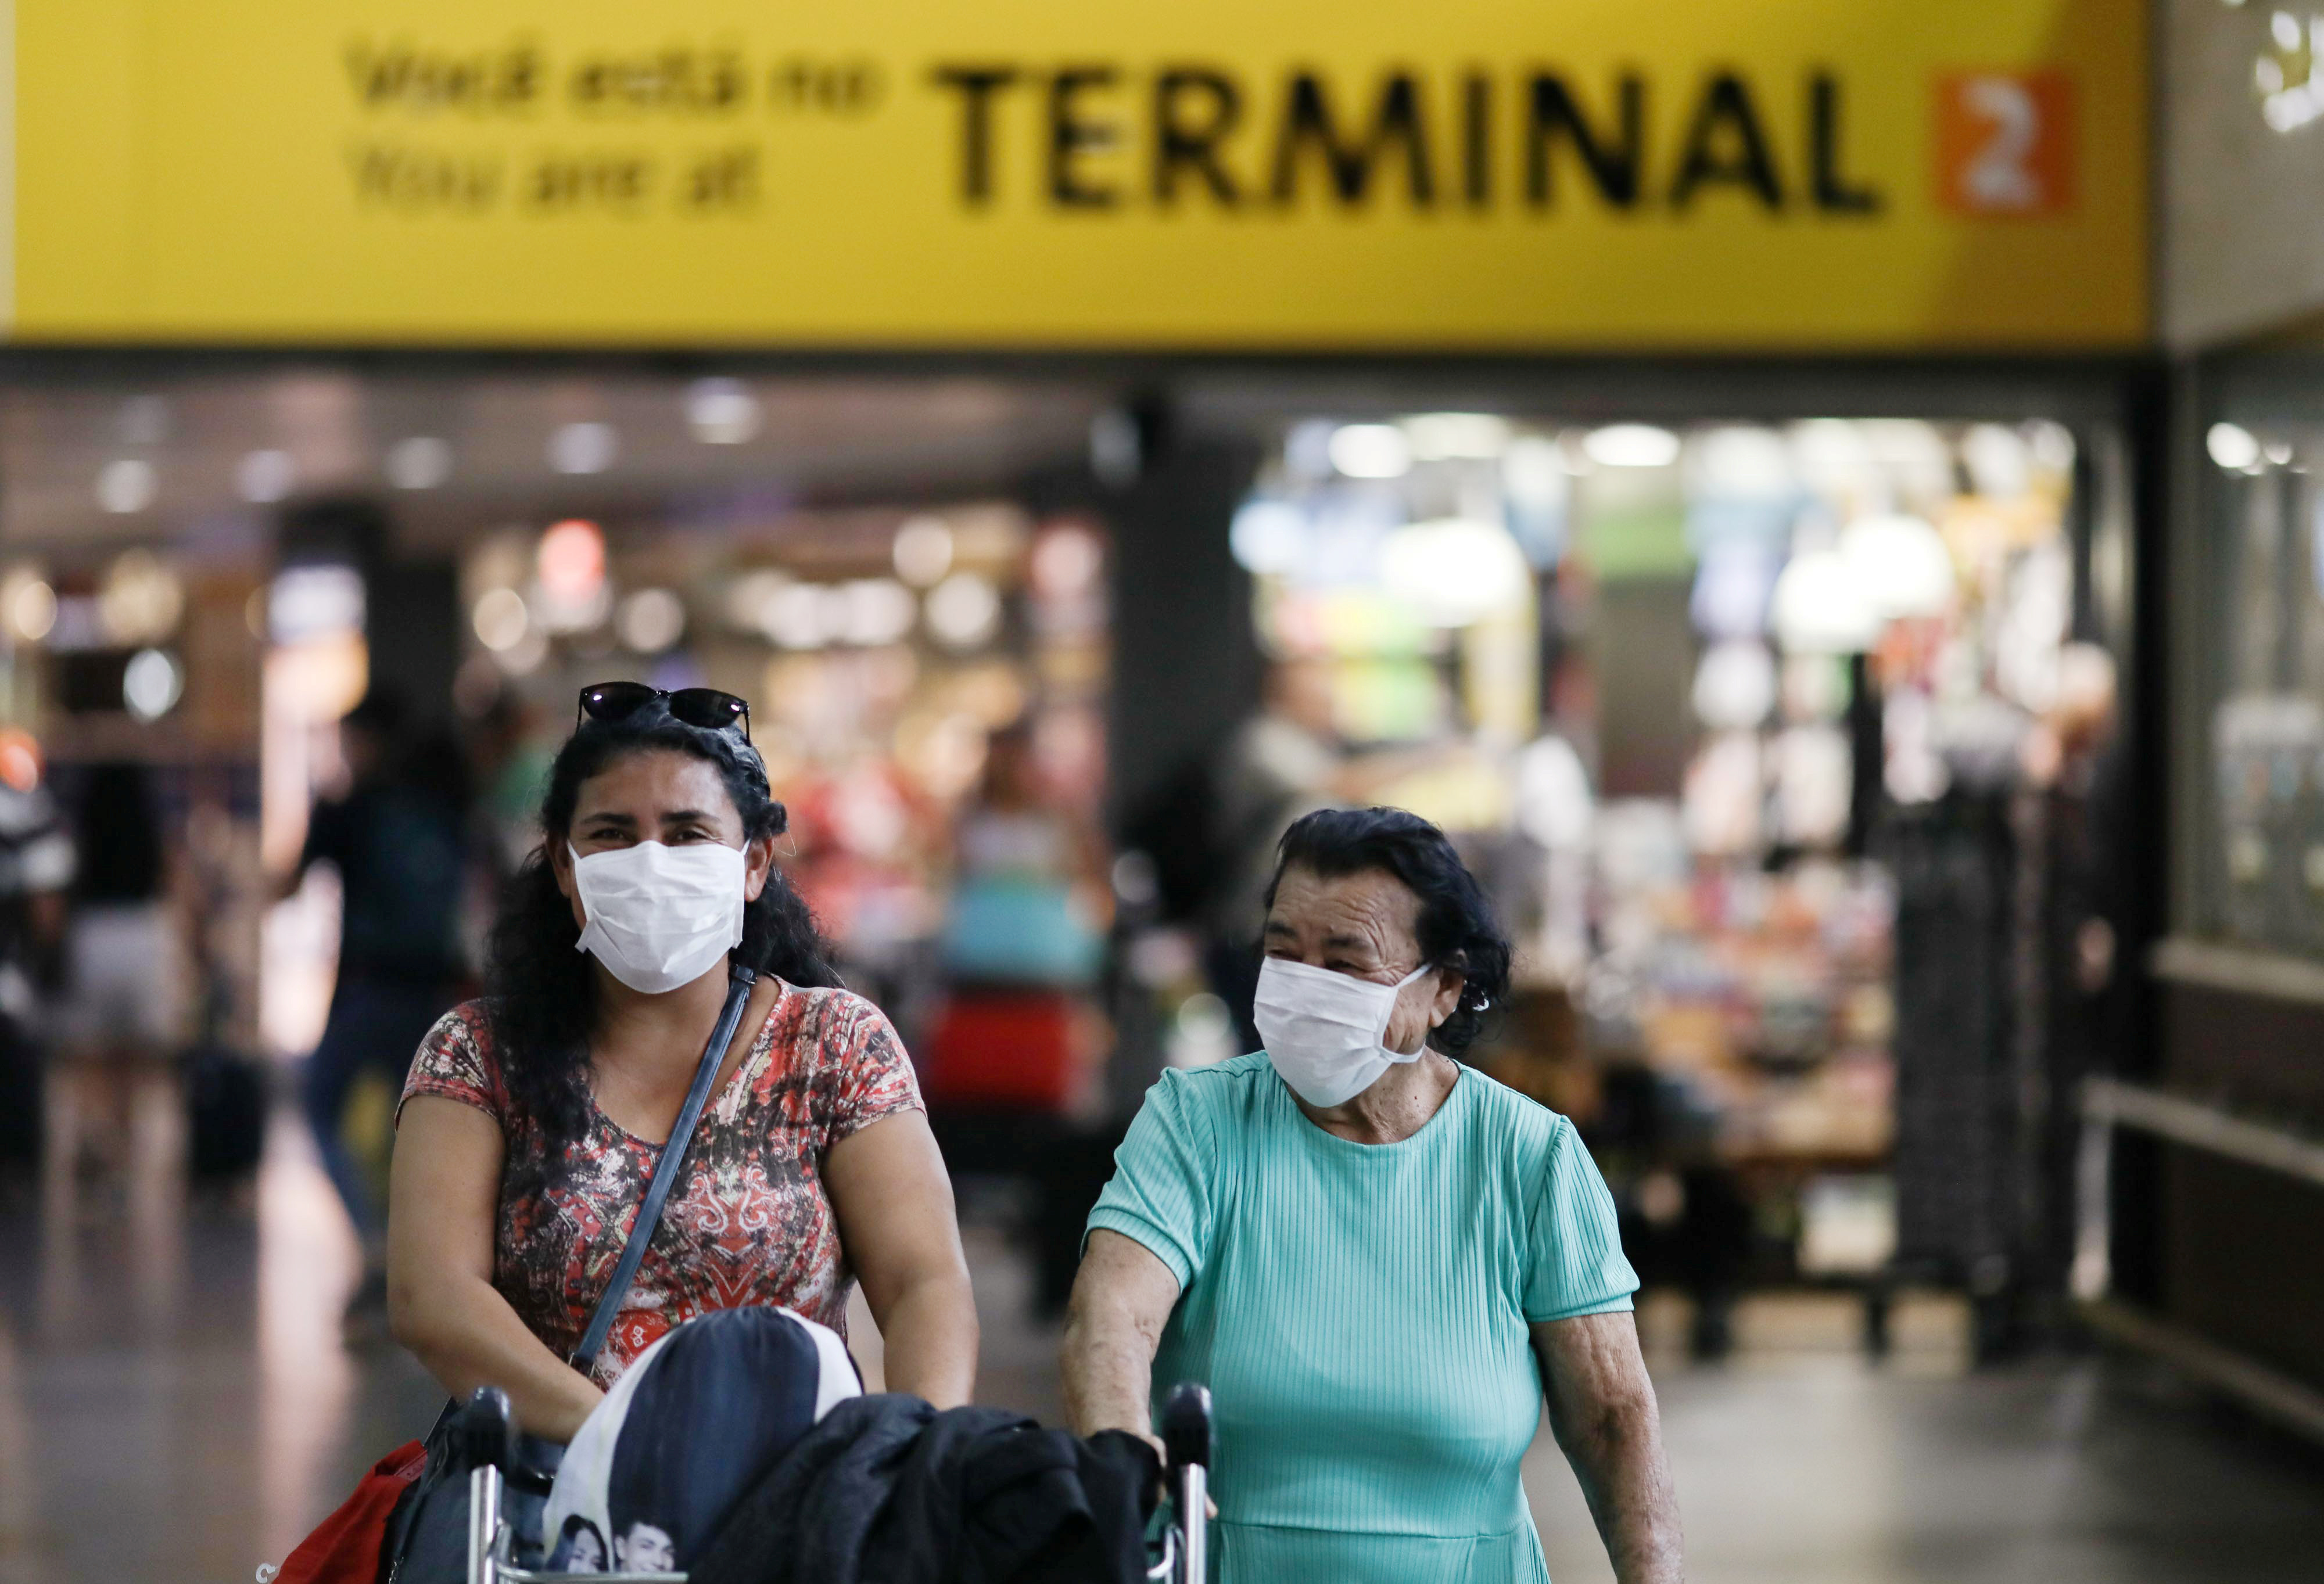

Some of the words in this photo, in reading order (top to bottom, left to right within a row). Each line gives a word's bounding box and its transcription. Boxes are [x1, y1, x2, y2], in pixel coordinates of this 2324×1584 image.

[526, 156, 650, 210] are
[930, 63, 1881, 214] TERMINAL
[1957, 76, 2040, 208] 2
